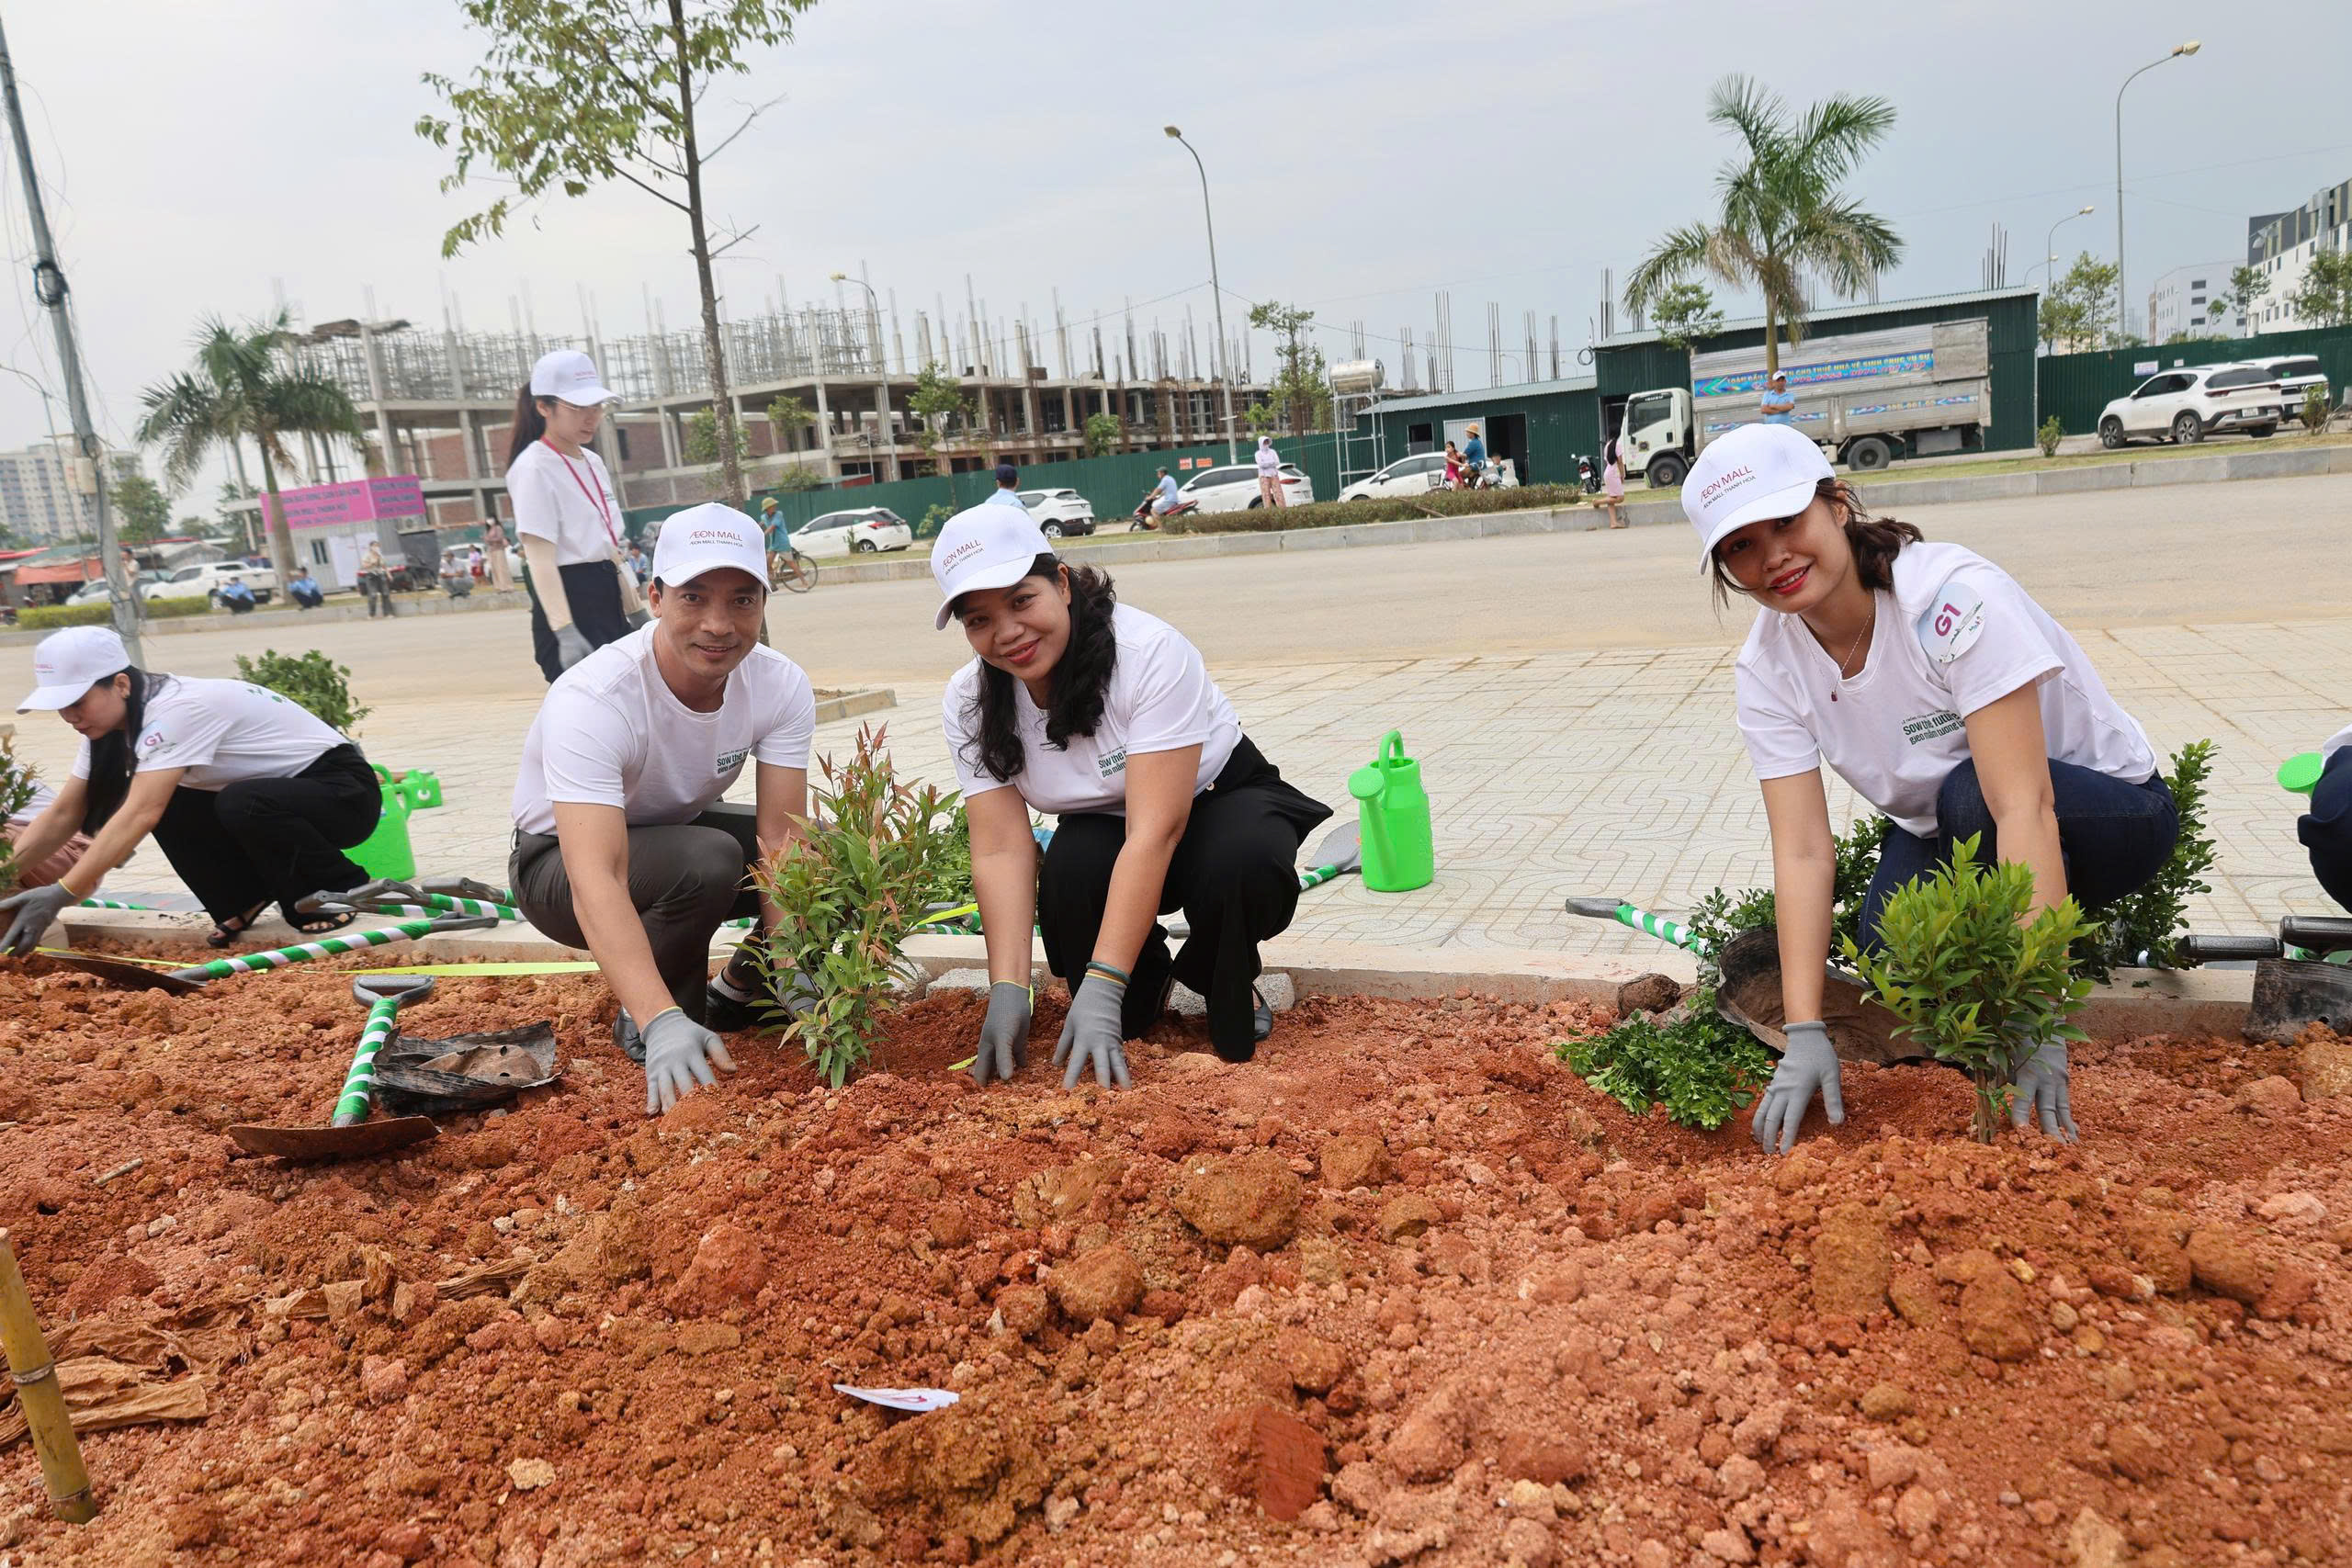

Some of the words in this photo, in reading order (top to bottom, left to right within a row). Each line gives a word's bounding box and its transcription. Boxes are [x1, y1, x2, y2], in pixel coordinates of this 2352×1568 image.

[1721, 465, 1753, 486] MALL
[1724, 481, 1743, 494] THANH
[717, 530, 742, 542] MALL
[956, 539, 981, 557] MALL
[1934, 603, 1962, 637] G1
[144, 731, 164, 747] G1
[1111, 752, 1125, 764] the
